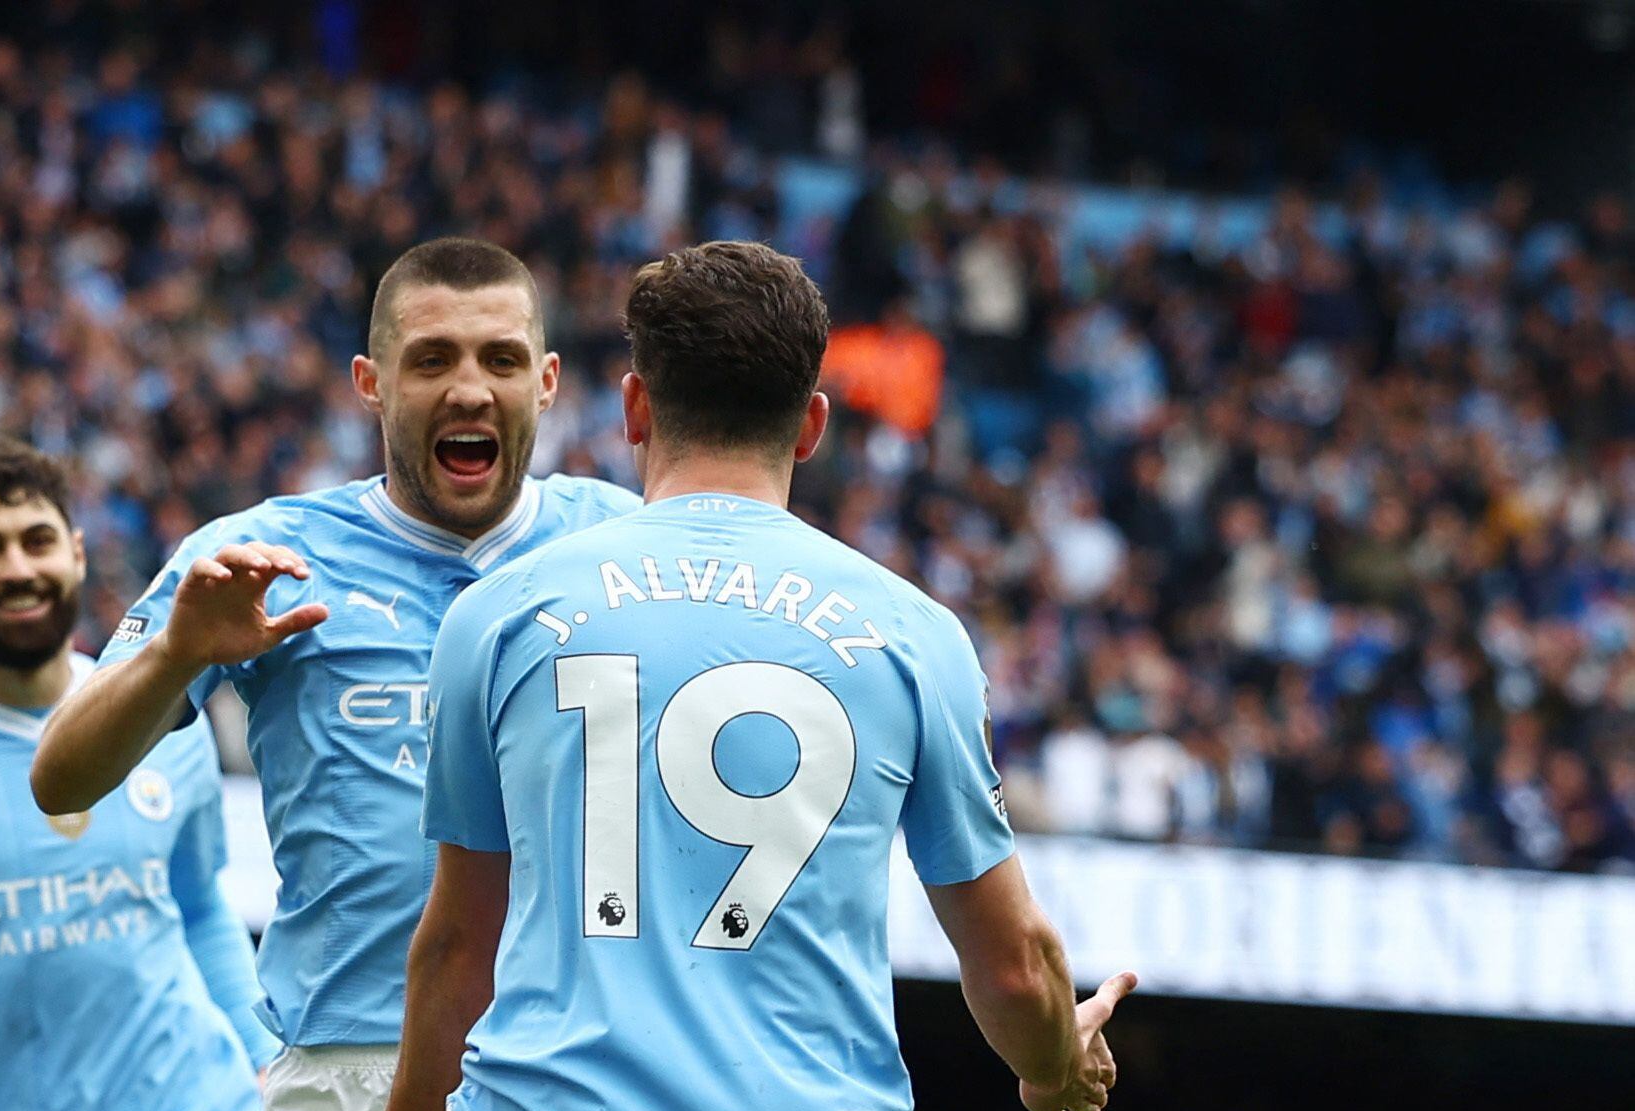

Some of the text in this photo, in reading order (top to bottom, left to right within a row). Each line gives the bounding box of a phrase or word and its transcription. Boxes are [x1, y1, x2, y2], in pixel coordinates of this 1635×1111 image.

[686, 497, 741, 513] CITY
[534, 554, 888, 669] J. ALVAREZ
[553, 653, 857, 952] 19
